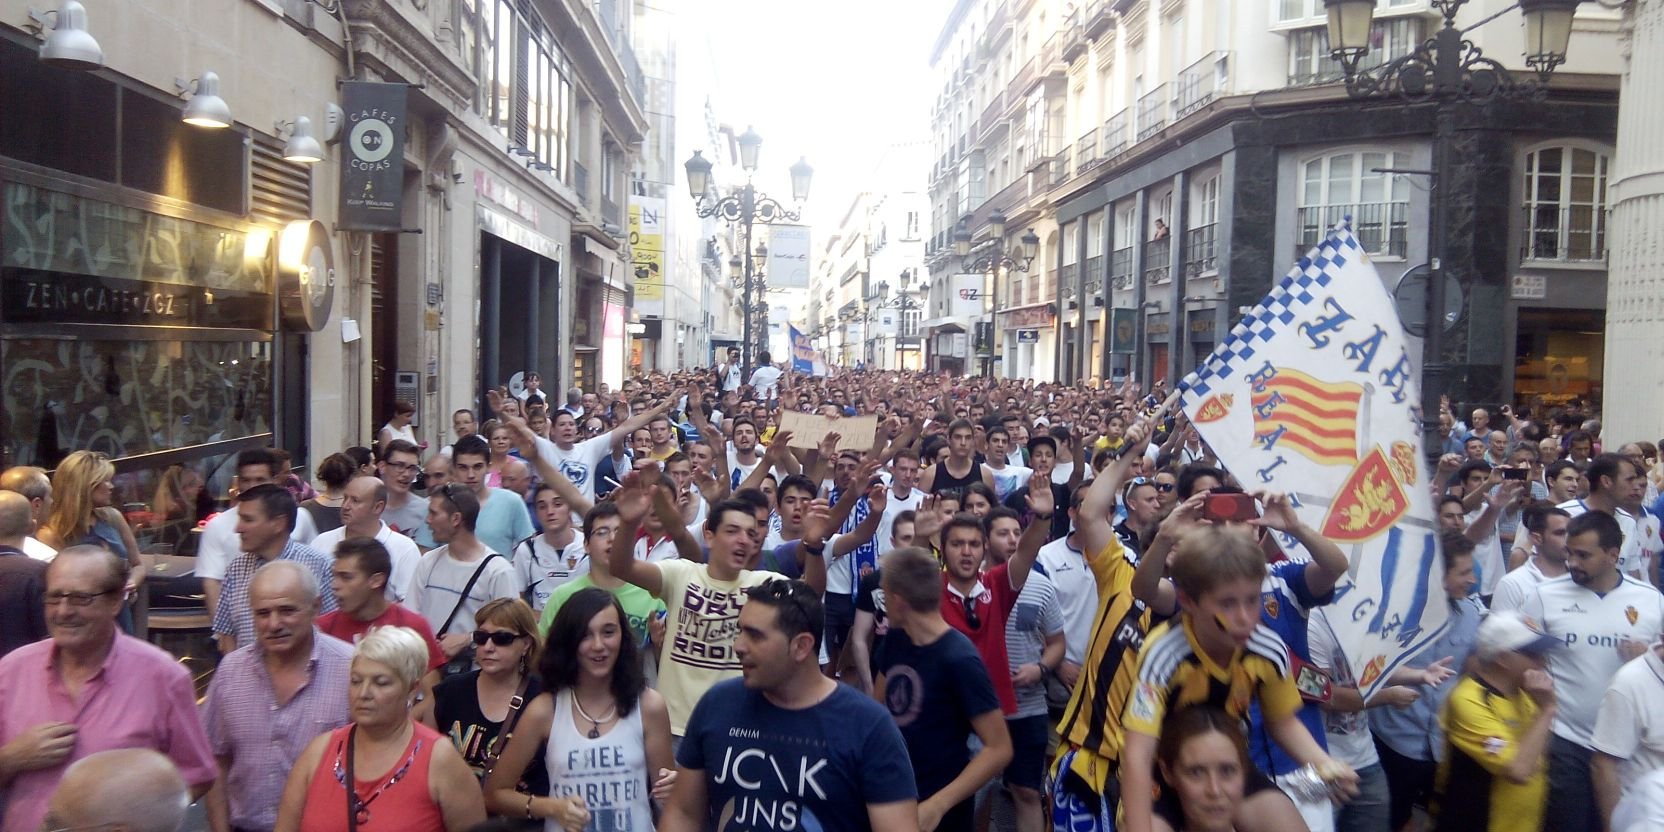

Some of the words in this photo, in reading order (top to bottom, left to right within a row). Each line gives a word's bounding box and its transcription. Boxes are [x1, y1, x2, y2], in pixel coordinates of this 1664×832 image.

[350, 108, 396, 125] CAFES
[350, 158, 391, 171] COPAS
[26, 282, 67, 309] ZEN
[143, 291, 175, 315] ZGZ
[1244, 360, 1288, 483] REAL
[674, 636, 734, 659] RADI
[729, 727, 760, 740] DENIM
[735, 796, 798, 831] JNS
